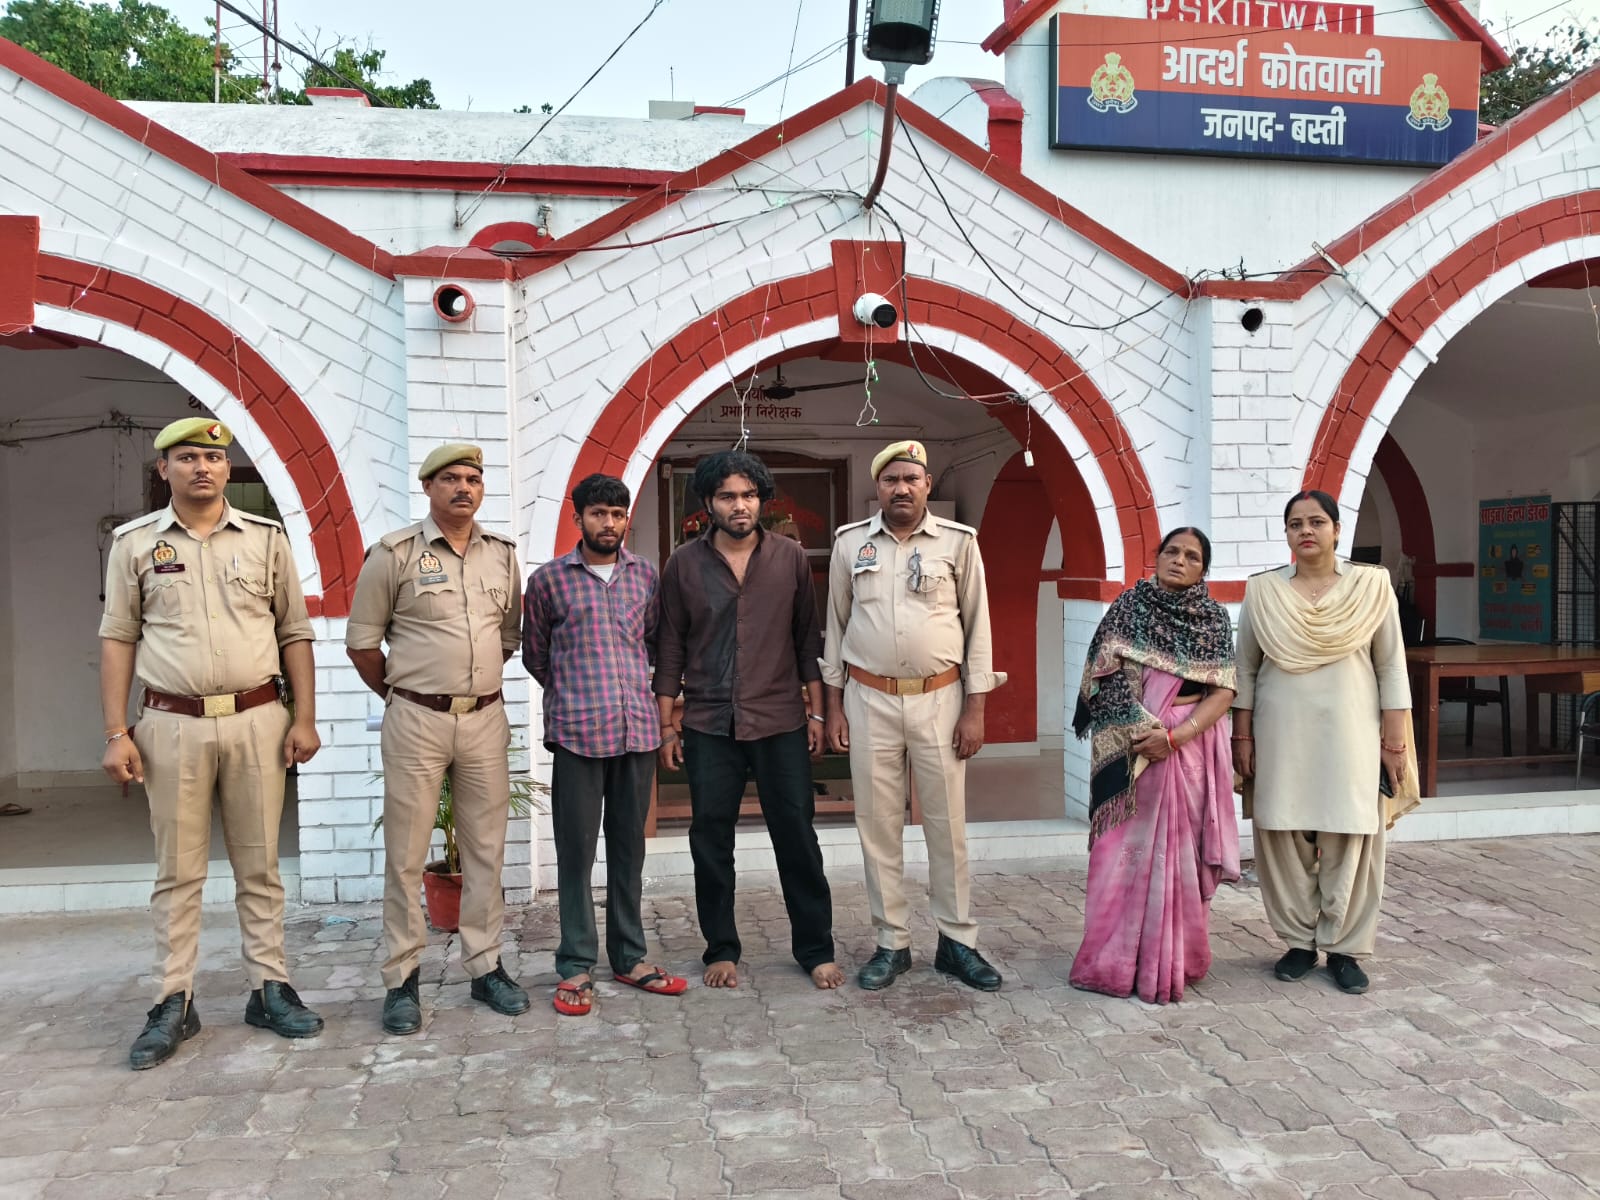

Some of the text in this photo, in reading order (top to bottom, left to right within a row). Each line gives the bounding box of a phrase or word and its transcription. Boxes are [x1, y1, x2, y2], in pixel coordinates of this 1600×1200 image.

[1162, 38, 1384, 96] आदर्श कोतवाली
[1289, 105, 1347, 146] बस्ती
[756, 403, 802, 421] निरीक्षक
